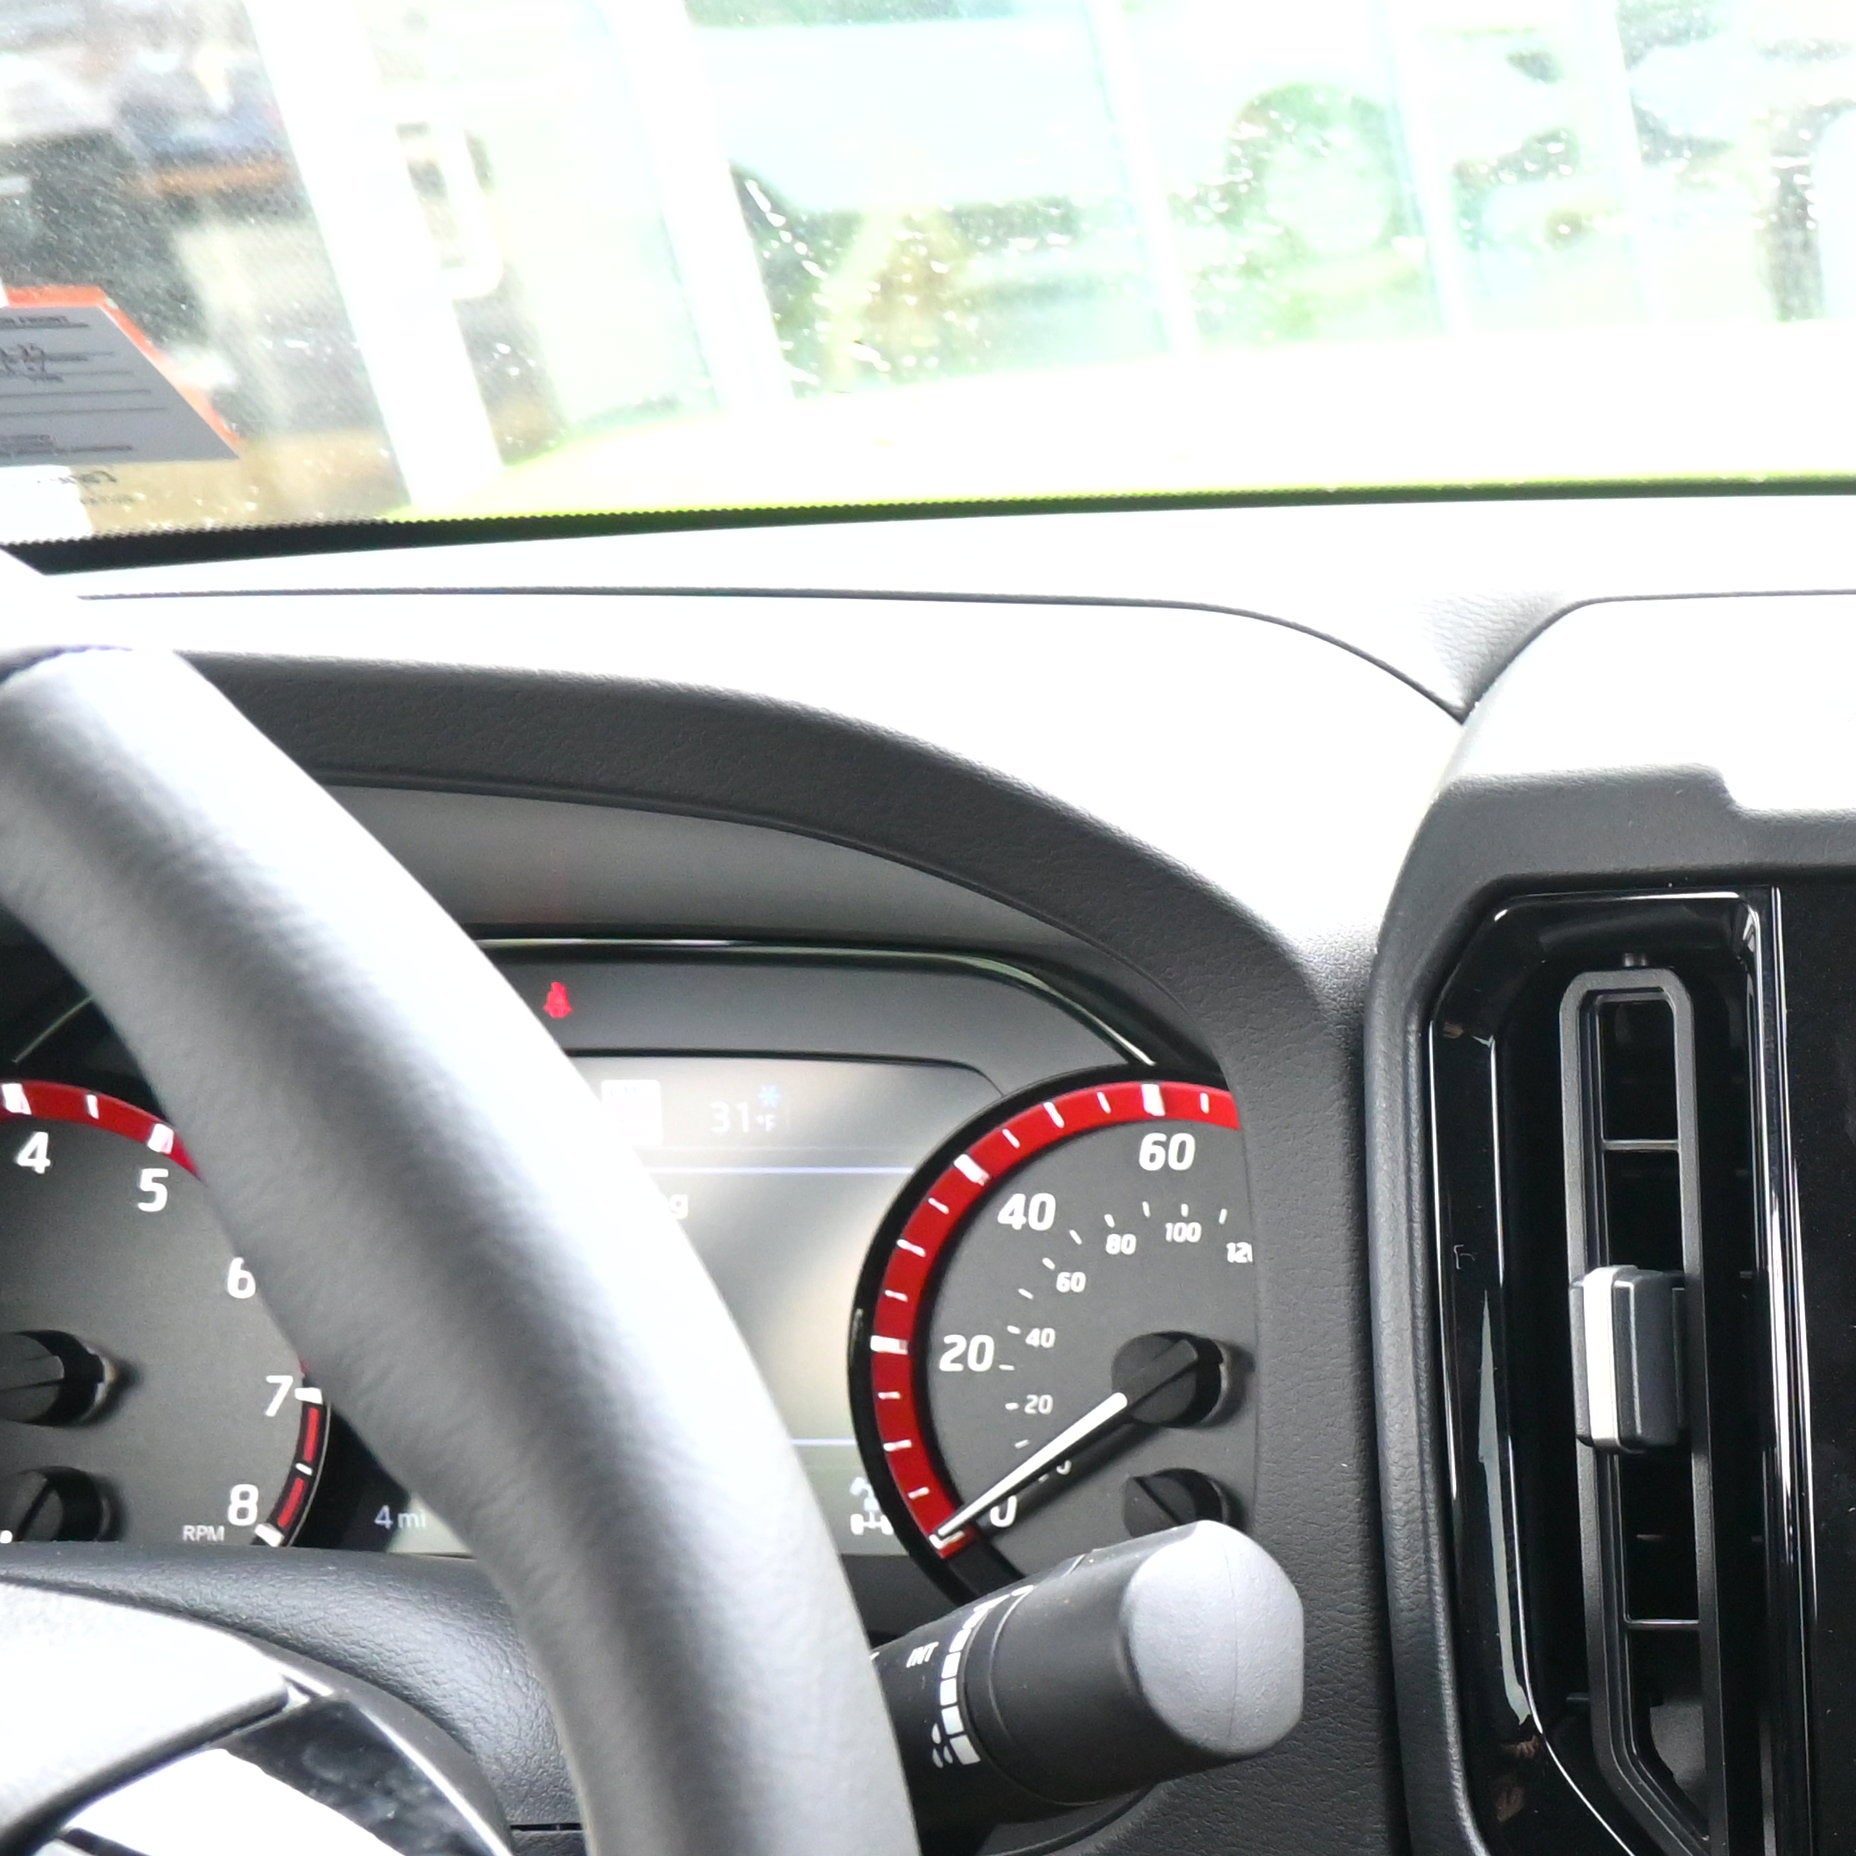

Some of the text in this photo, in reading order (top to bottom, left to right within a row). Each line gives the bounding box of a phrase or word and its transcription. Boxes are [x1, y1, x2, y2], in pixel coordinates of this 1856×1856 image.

[709, 1101, 750, 1133] 31
[16, 1131, 51, 1174] 4
[1138, 1132, 1196, 1171] 60
[136, 1167, 170, 1212] 5
[997, 1192, 1057, 1231] 40
[1104, 1233, 1137, 1255] 80
[1165, 1221, 1202, 1243] 100
[226, 1257, 257, 1299] 6
[1055, 1271, 1087, 1293] 60
[938, 1334, 995, 1373] 20
[1025, 1328, 1056, 1349] 40
[265, 1374, 295, 1417] 7
[1024, 1395, 1054, 1415] 20
[227, 1483, 259, 1527] 8
[397, 1505, 427, 1528] mi
[182, 1523, 226, 1543] RPM
[906, 1641, 940, 1669] INT
